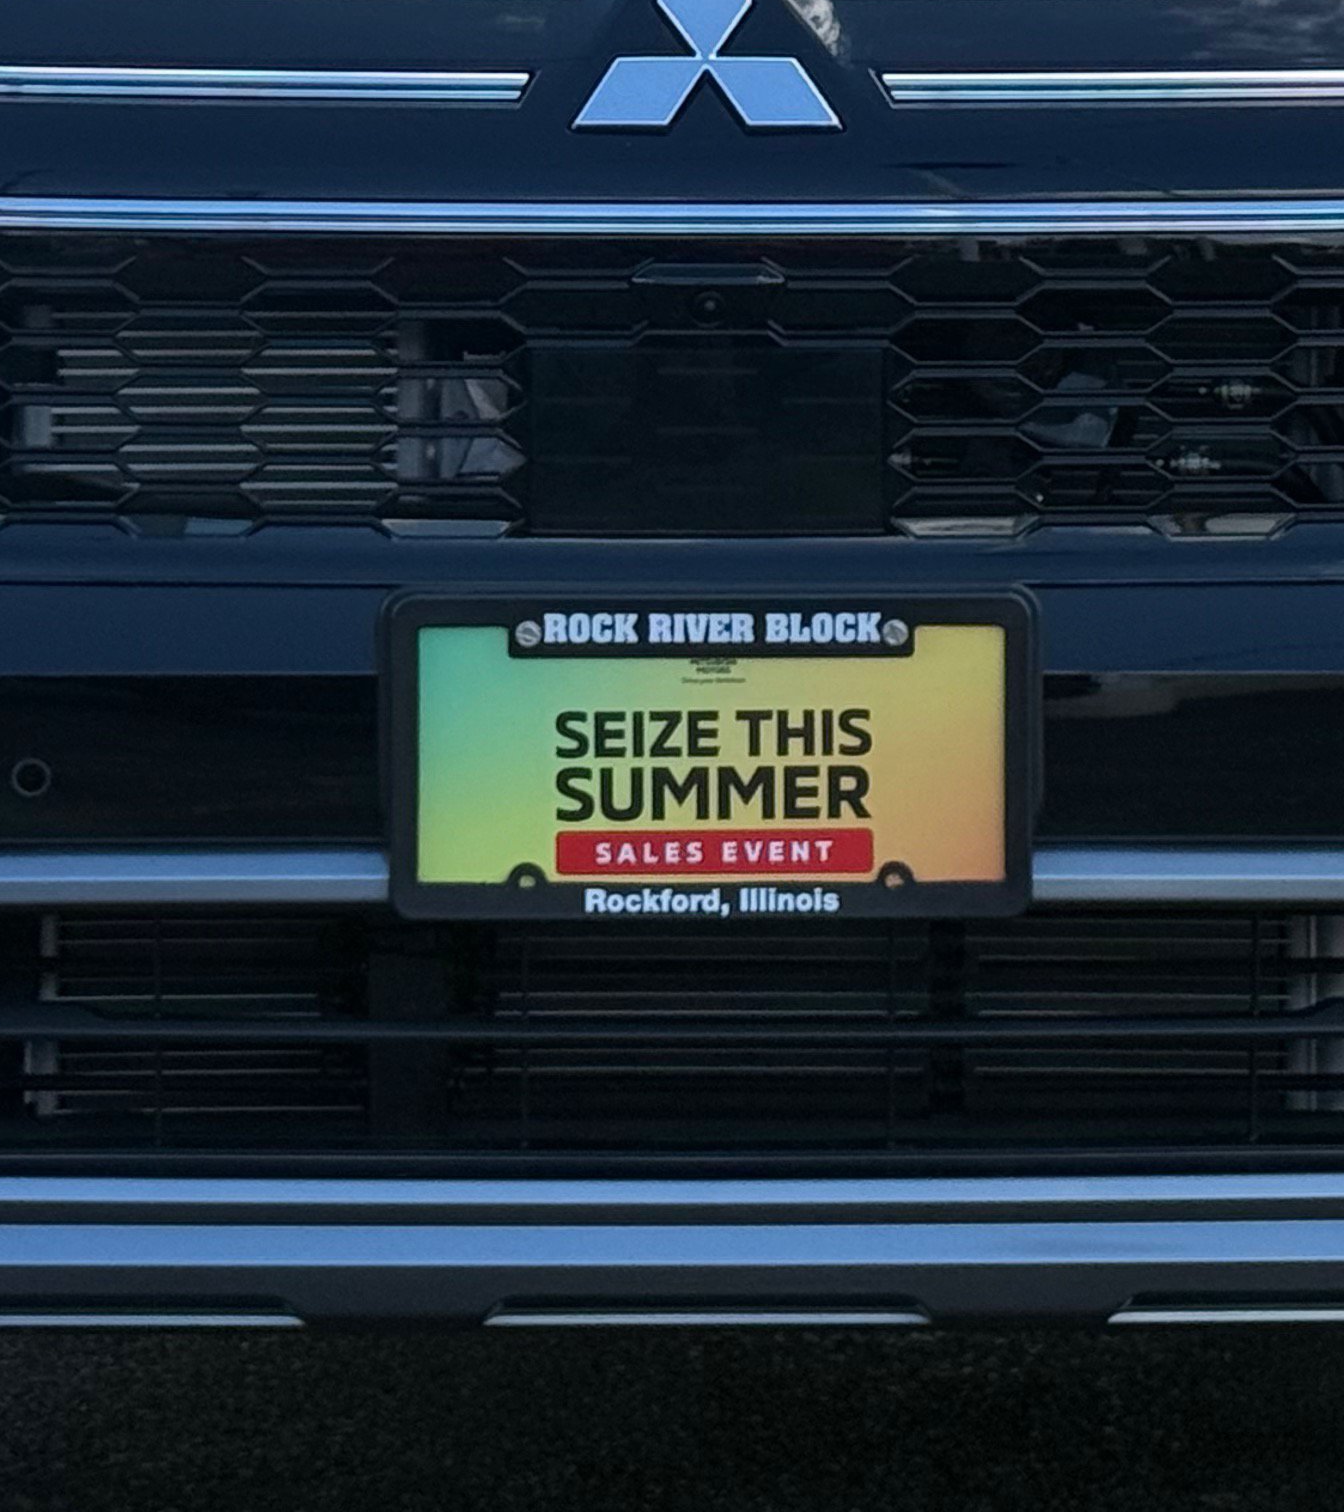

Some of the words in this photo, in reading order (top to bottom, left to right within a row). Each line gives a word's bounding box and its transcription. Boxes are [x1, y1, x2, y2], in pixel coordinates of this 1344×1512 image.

[543, 612, 638, 644] ROCK
[648, 612, 755, 644] RIVER
[765, 612, 882, 643] BLOCK
[555, 710, 720, 758] SEIZE
[736, 709, 872, 757] THIS
[556, 765, 872, 821] SUMMER
[595, 842, 703, 865] SALES
[722, 840, 835, 863] EVENT
[584, 889, 730, 916] Rockford,
[739, 889, 840, 913] Illinois
